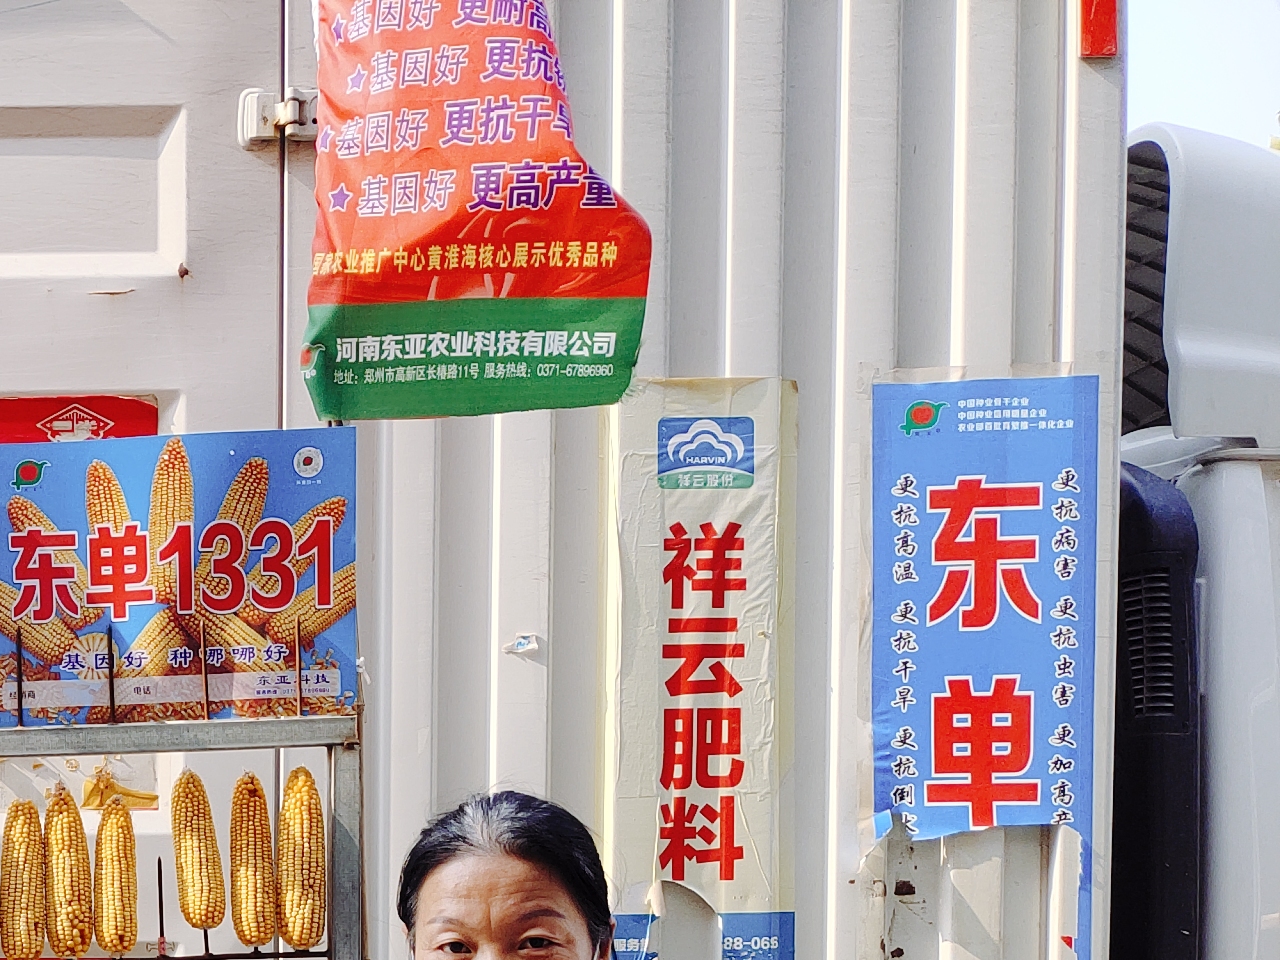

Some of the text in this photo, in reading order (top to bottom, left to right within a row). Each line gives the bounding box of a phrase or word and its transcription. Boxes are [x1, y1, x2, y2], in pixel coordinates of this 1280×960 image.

[370, 45, 469, 93] 基因好
[336, 96, 574, 158] 基因好 更抗干旱
[358, 159, 617, 217] 基因好 更高产量
[312, 241, 618, 275] 国家农业推广中心黄淮海核心展示优秀品种
[335, 331, 617, 364] 河南东亚农业科技有限公司
[677, 473, 734, 487] 祥云股份
[685, 456, 726, 464] HARVIN
[890, 474, 920, 584] 更抗高温
[1051, 467, 1081, 582] 更抗病害
[8, 515, 340, 623] 东单1331
[60, 643, 290, 673] 基因好 种哪哪好
[890, 600, 919, 713] 更抗干旱
[924, 474, 1044, 831] 东单
[1050, 596, 1080, 708] 更抗虫害
[658, 520, 748, 881] 祥云肥料
